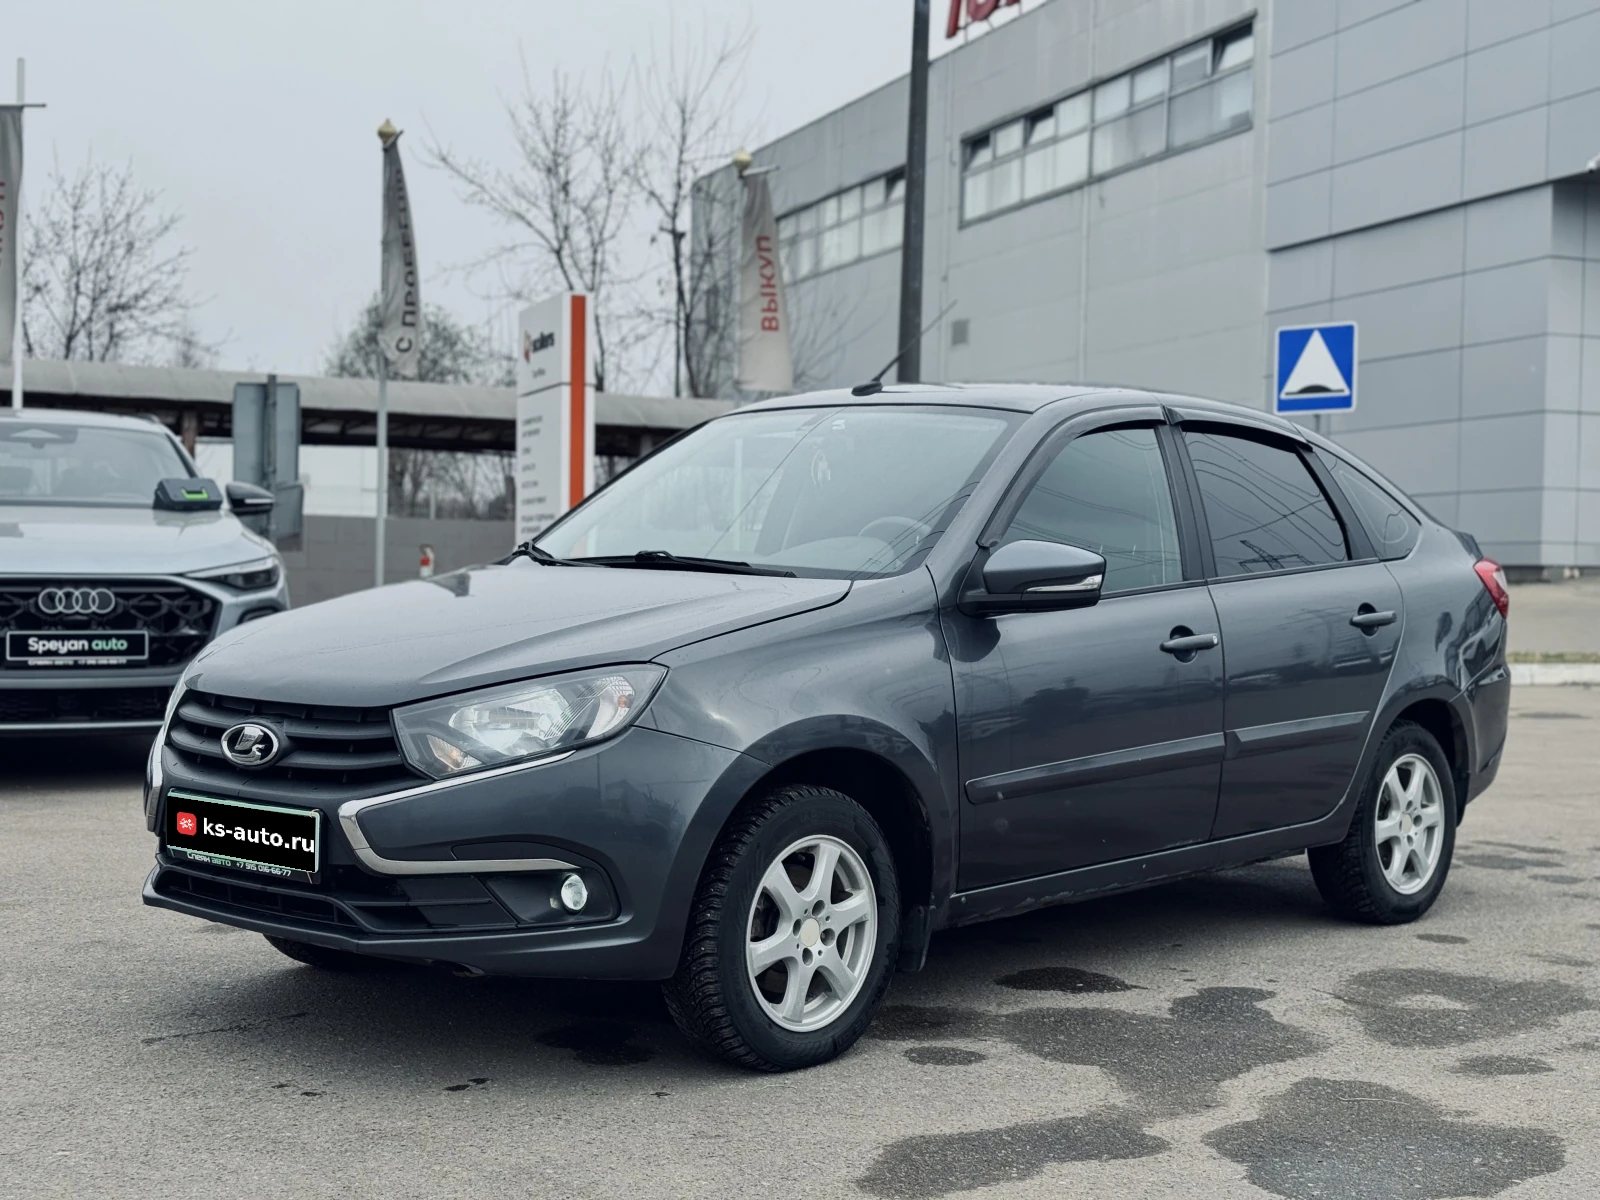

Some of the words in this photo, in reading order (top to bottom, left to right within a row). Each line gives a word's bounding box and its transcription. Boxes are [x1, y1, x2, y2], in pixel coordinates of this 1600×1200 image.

[755, 235, 779, 332] ВЫКУП
[27, 637, 89, 654] Speyan
[91, 637, 128, 651] auto
